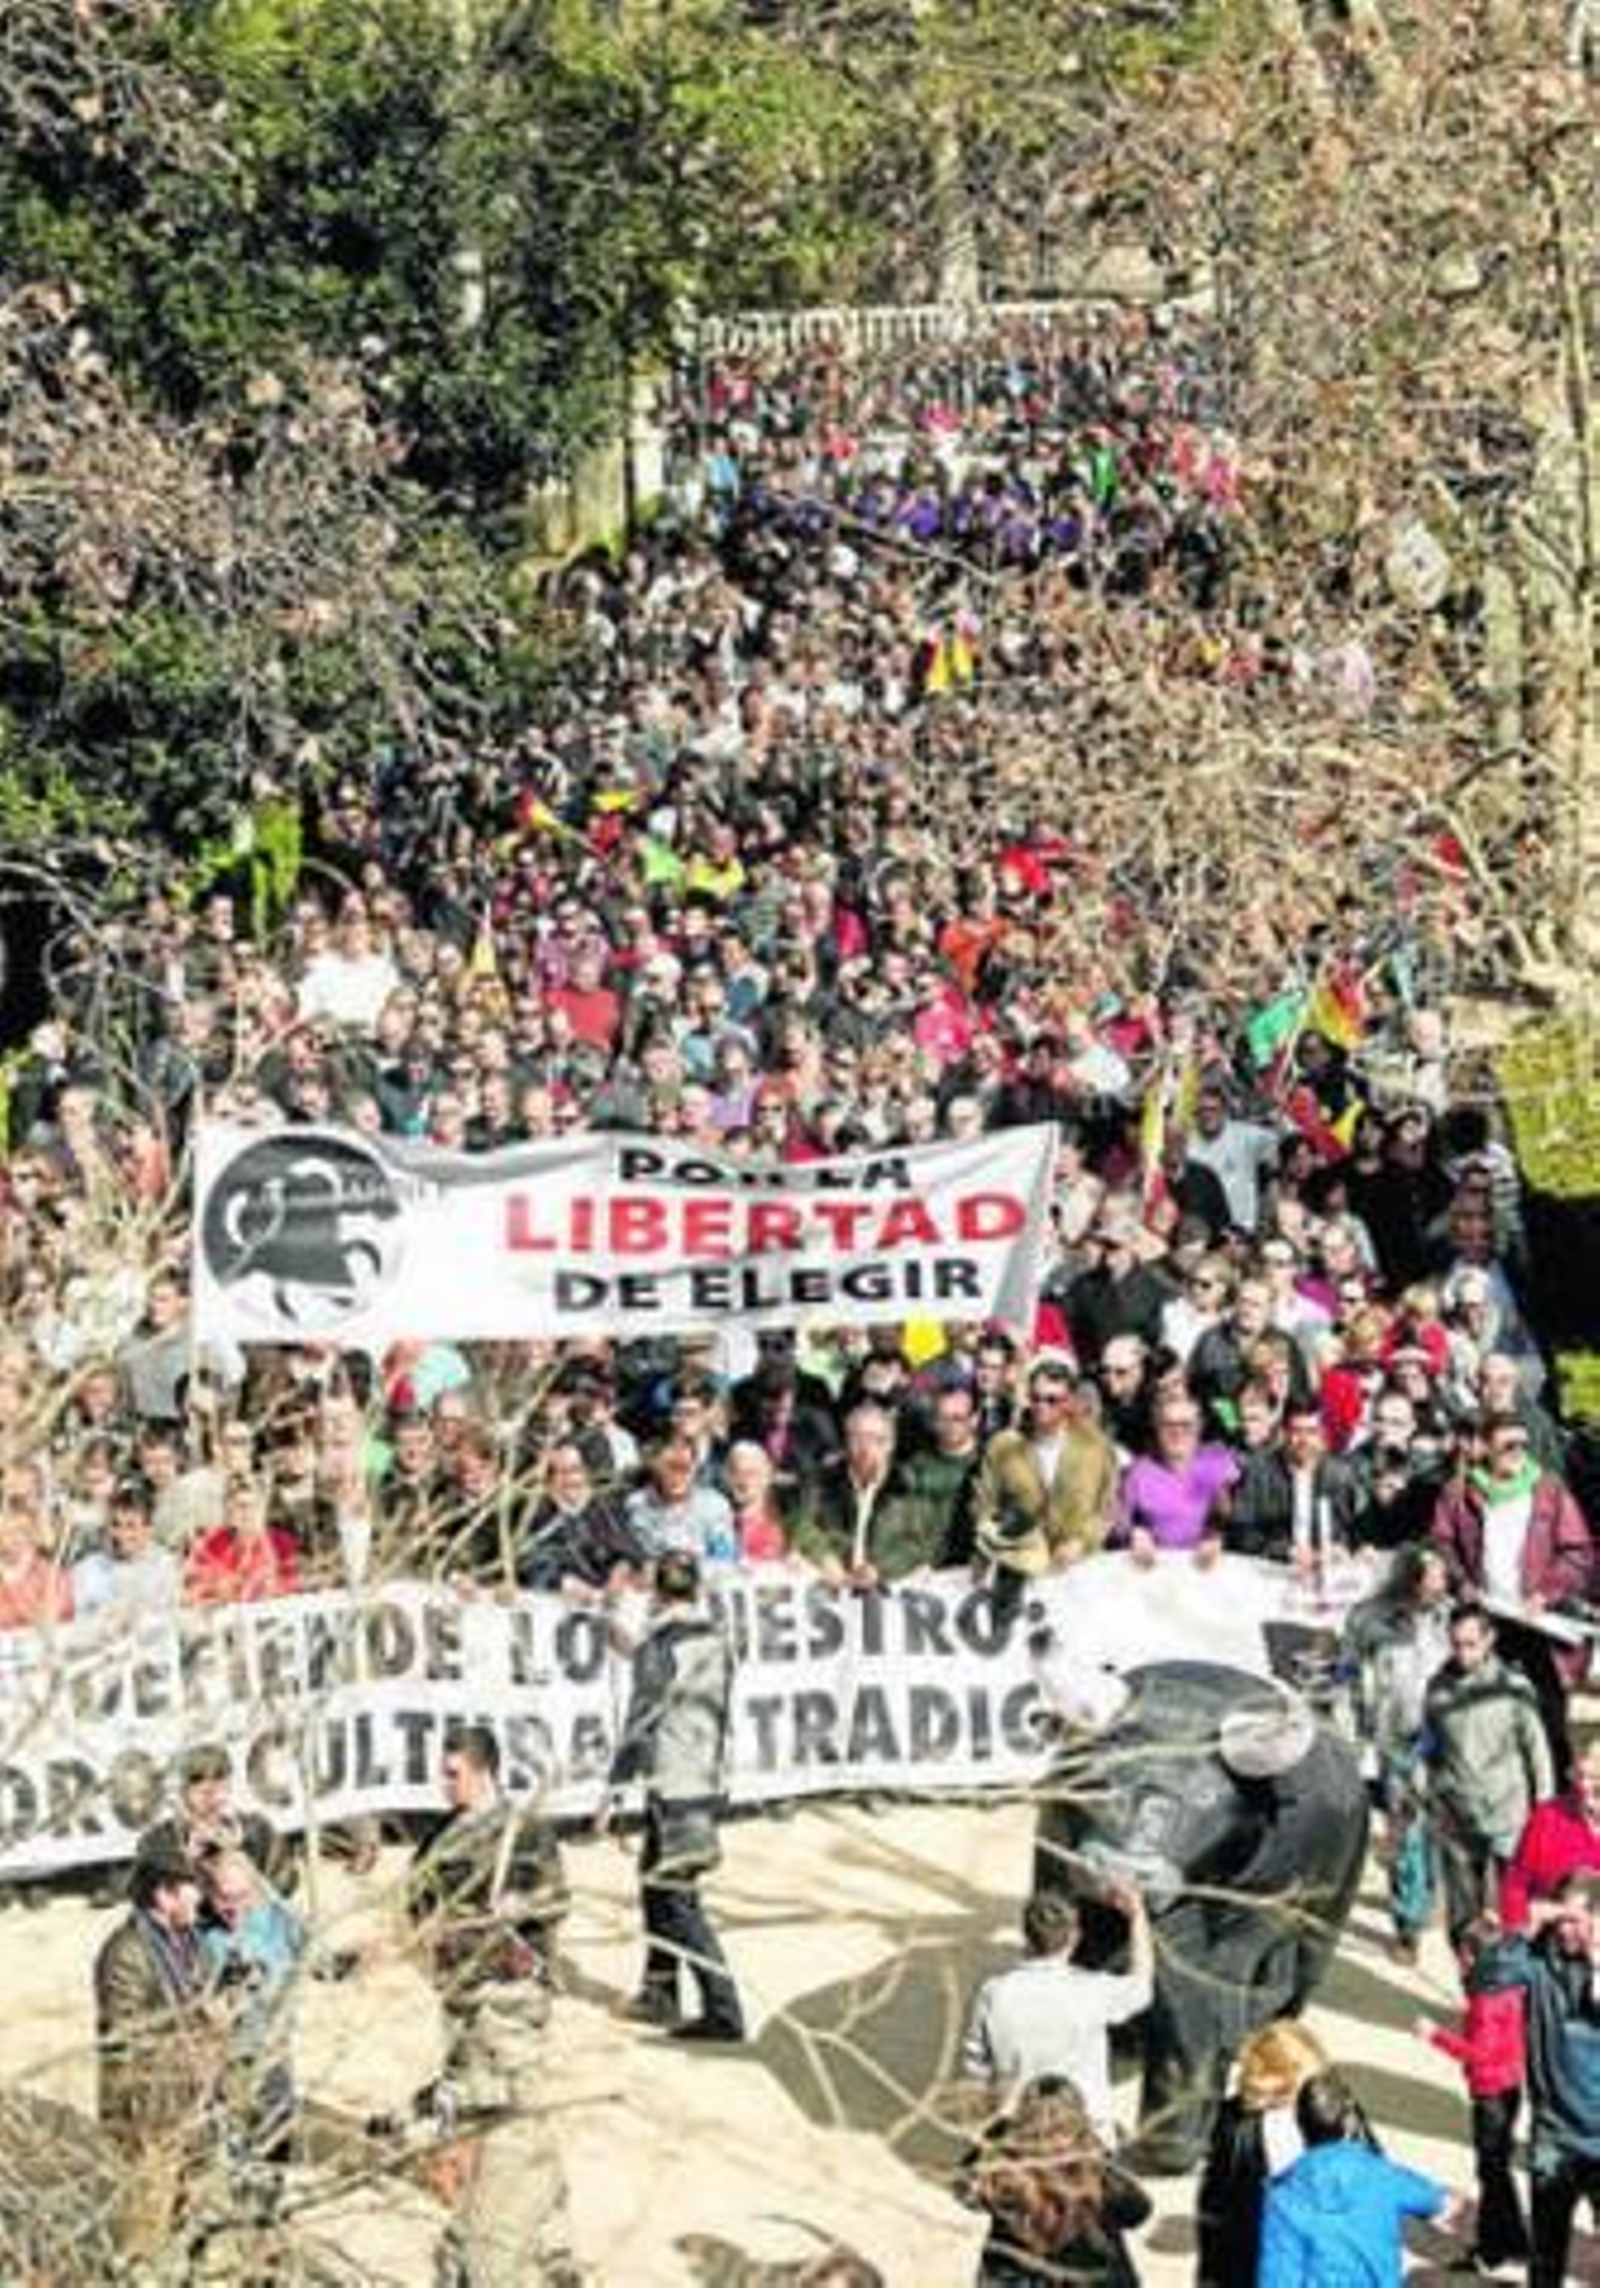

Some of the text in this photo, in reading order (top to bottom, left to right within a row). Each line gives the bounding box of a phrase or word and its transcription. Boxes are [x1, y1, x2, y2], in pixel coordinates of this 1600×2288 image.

[507, 1192, 1027, 1257] LIBERTAD
[555, 1257, 982, 1311] DE ELEGIR
[511, 1611, 608, 1686] LO
